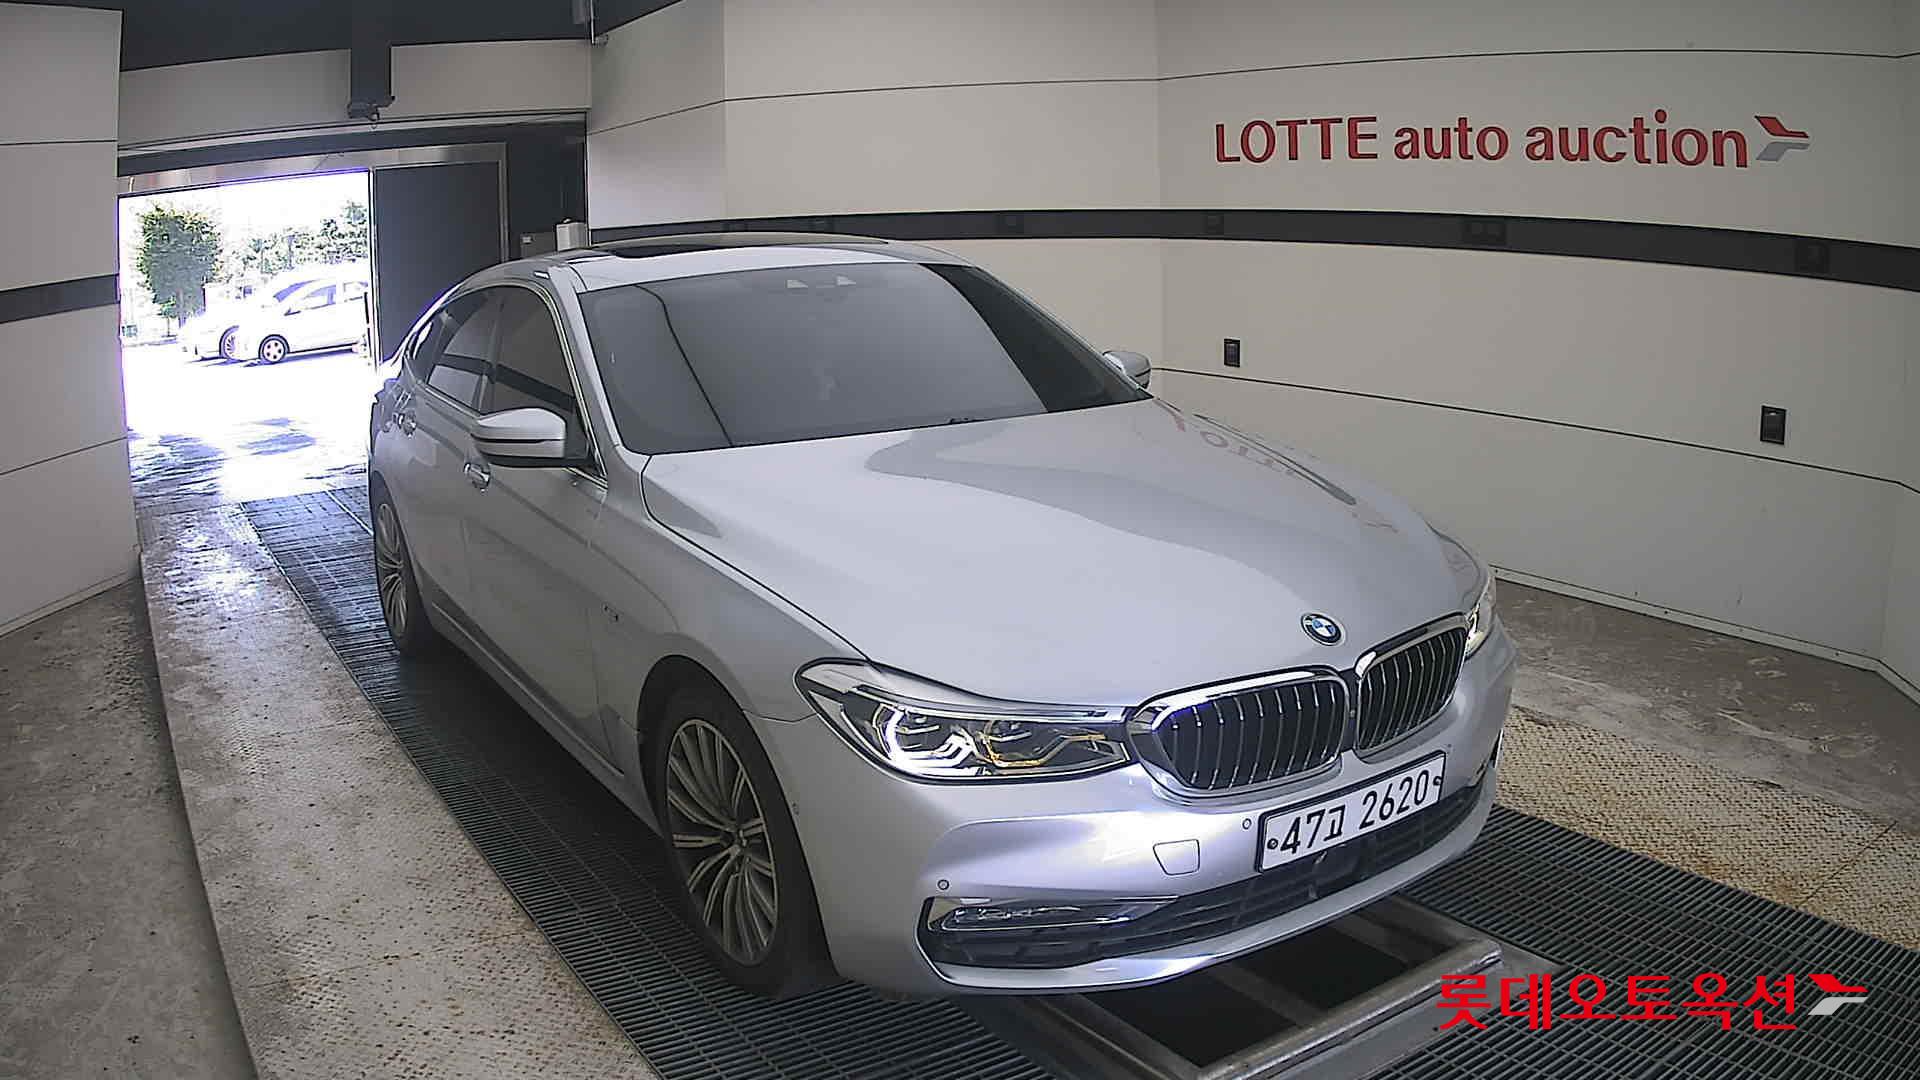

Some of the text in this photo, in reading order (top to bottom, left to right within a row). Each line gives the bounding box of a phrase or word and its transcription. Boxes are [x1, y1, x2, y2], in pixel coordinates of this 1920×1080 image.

[1215, 109, 1749, 168] LOTTE auto auction
[1280, 769, 1429, 854] 47고 2620
